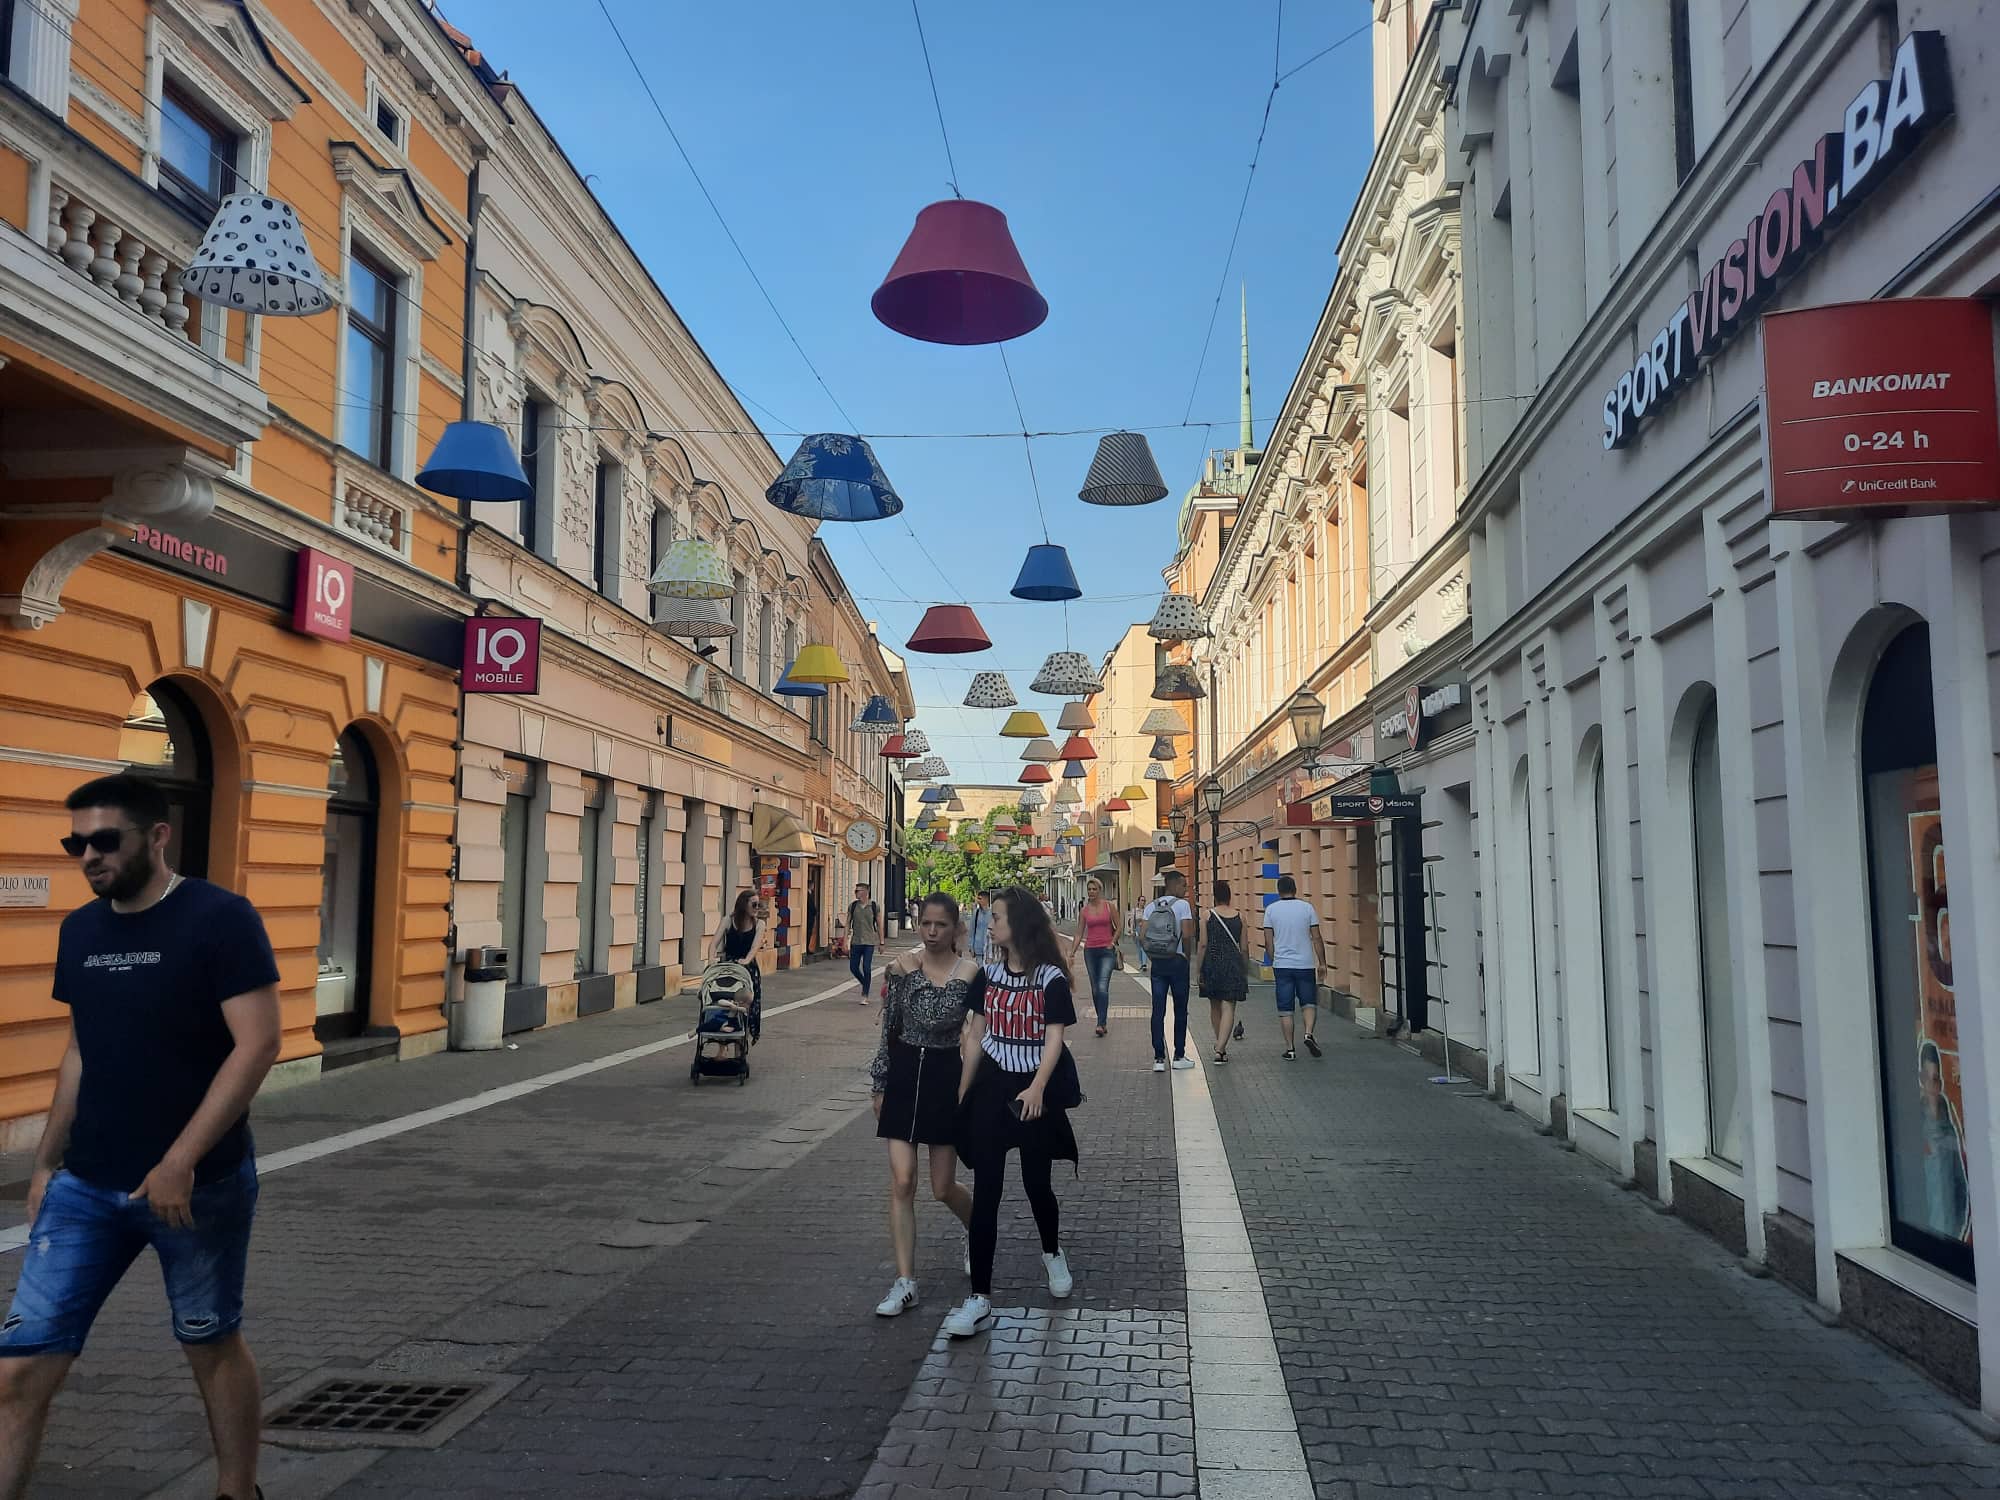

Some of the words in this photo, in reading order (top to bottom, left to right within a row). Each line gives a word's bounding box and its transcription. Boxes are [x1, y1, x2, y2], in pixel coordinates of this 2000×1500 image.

[1602, 33, 1925, 450] SPORTVISION.BA
[1812, 373, 1951, 398] BANKOMAT
[1844, 431, 1904, 452] 0-24
[1913, 430, 1929, 449] h
[1858, 479, 1908, 492] UniCredit
[1910, 478, 1937, 489] Bank
[315, 564, 345, 615] IQ
[314, 611, 343, 630] MOBILE
[476, 628, 526, 671] IQ
[475, 673, 524, 683] MOBILE
